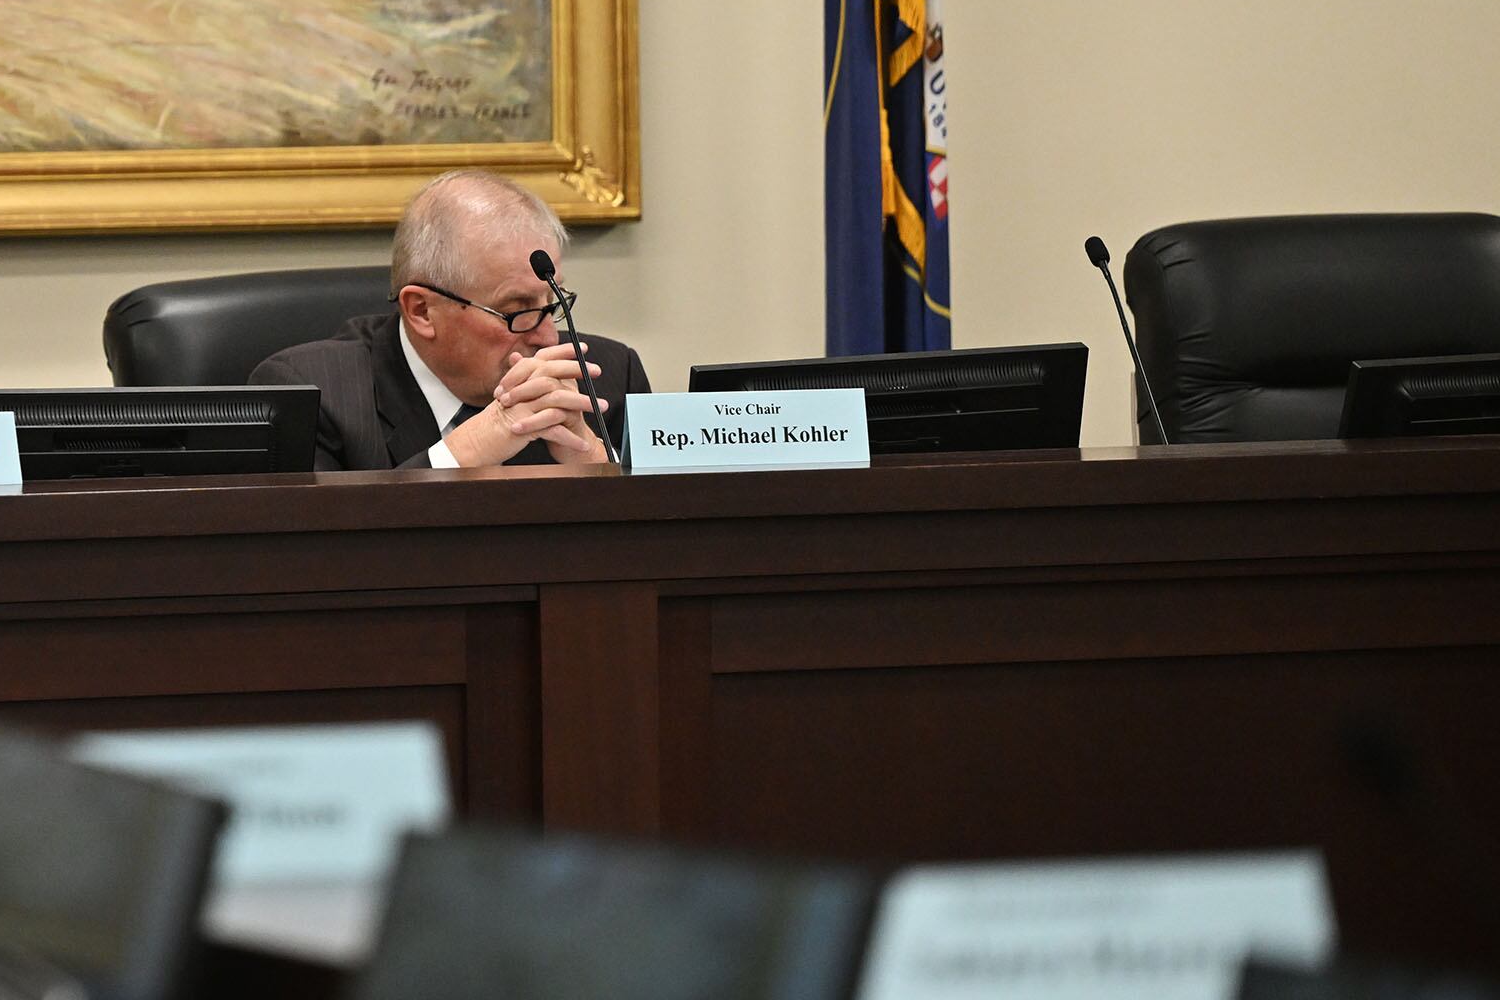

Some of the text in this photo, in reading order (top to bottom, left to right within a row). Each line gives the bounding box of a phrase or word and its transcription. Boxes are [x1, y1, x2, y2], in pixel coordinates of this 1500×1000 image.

[714, 403, 782, 416] Vice Chair
[651, 425, 849, 450] Rep. Michael Kohler
